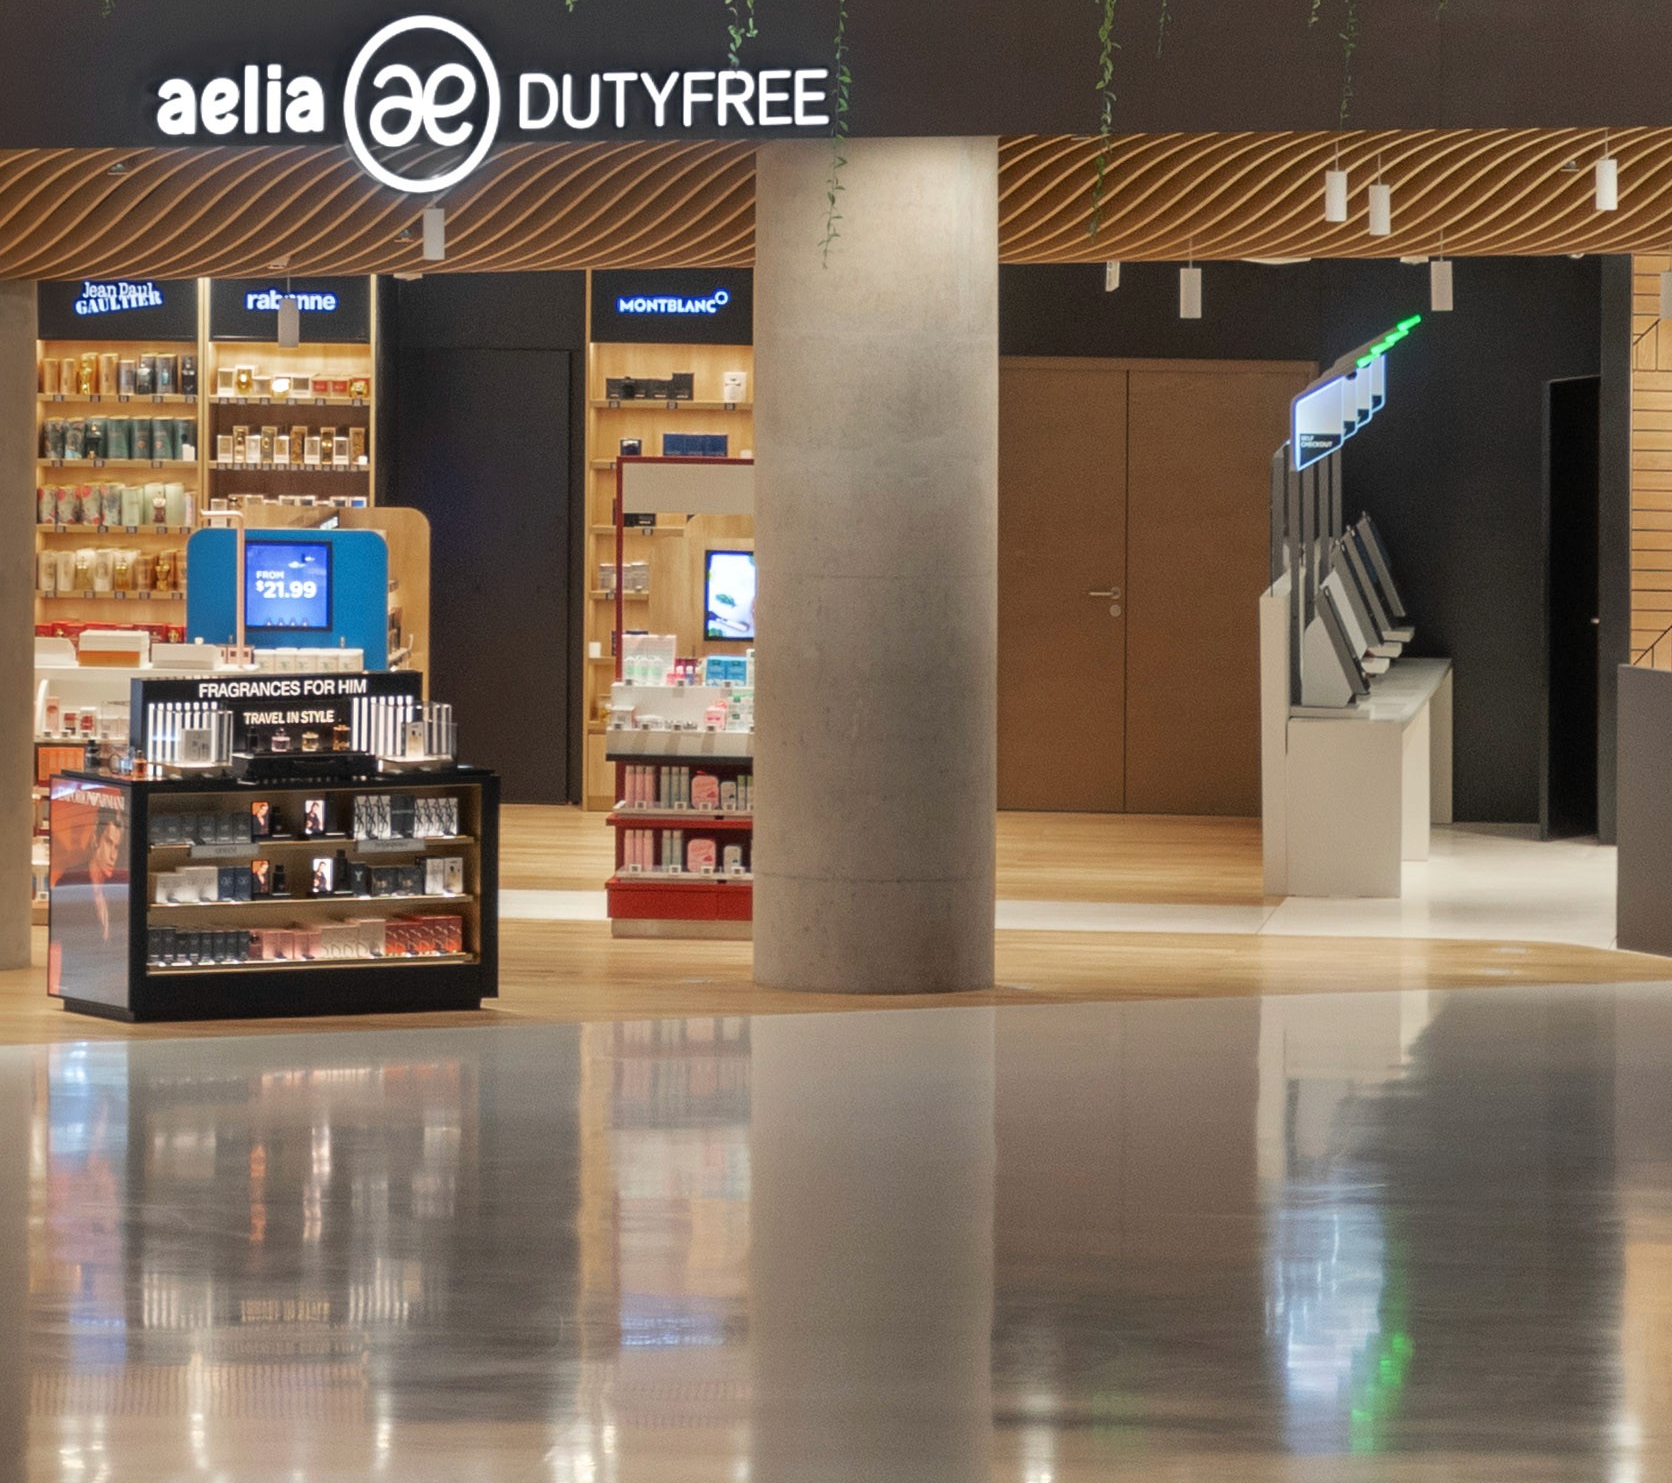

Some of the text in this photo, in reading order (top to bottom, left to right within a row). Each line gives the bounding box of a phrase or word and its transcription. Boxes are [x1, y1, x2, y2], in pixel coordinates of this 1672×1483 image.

[156, 63, 325, 136] aelia
[82, 281, 154, 299] Jean Paul
[75, 290, 163, 315] GAULTIER
[247, 290, 337, 311] rabnne
[619, 297, 717, 314] MONTBLANC
[256, 571, 285, 580] FROM
[255, 580, 317, 600] $21.99
[199, 678, 368, 699] FRAGRANCES FOR HIM
[243, 709, 335, 725] TRAVEL IN STYLE
